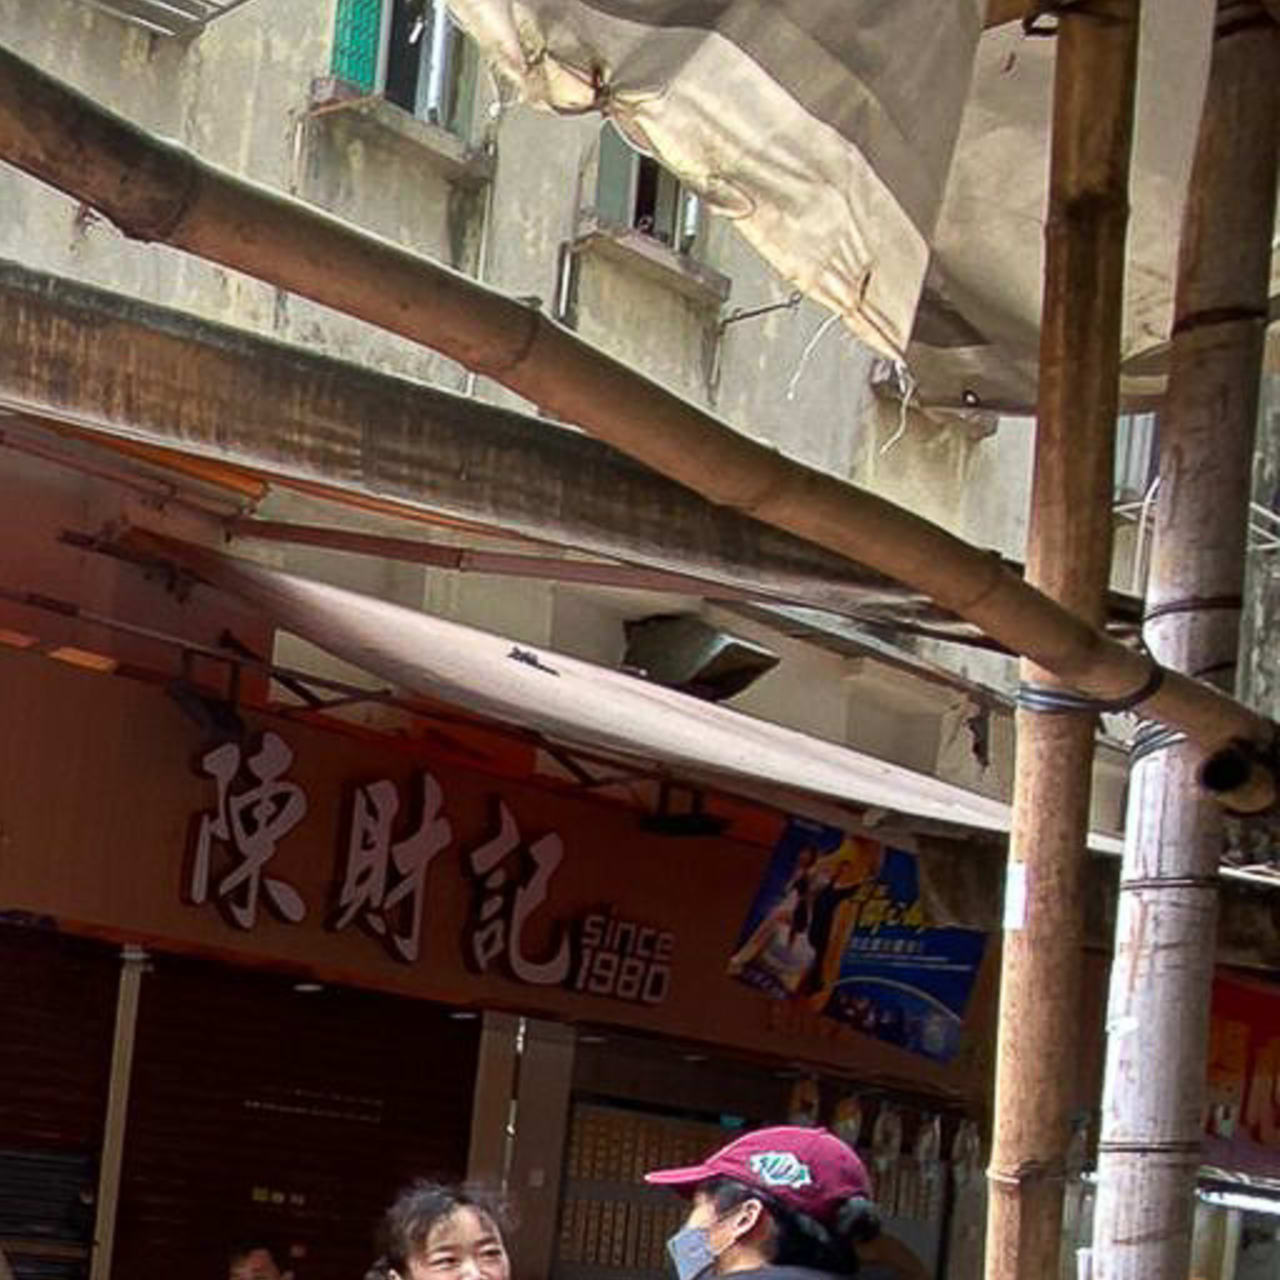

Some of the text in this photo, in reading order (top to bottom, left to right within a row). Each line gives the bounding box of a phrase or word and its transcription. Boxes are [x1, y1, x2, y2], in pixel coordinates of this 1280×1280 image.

[191, 731, 572, 985] 陳財記
[582, 905, 677, 961] since
[575, 946, 672, 1005] 1980
